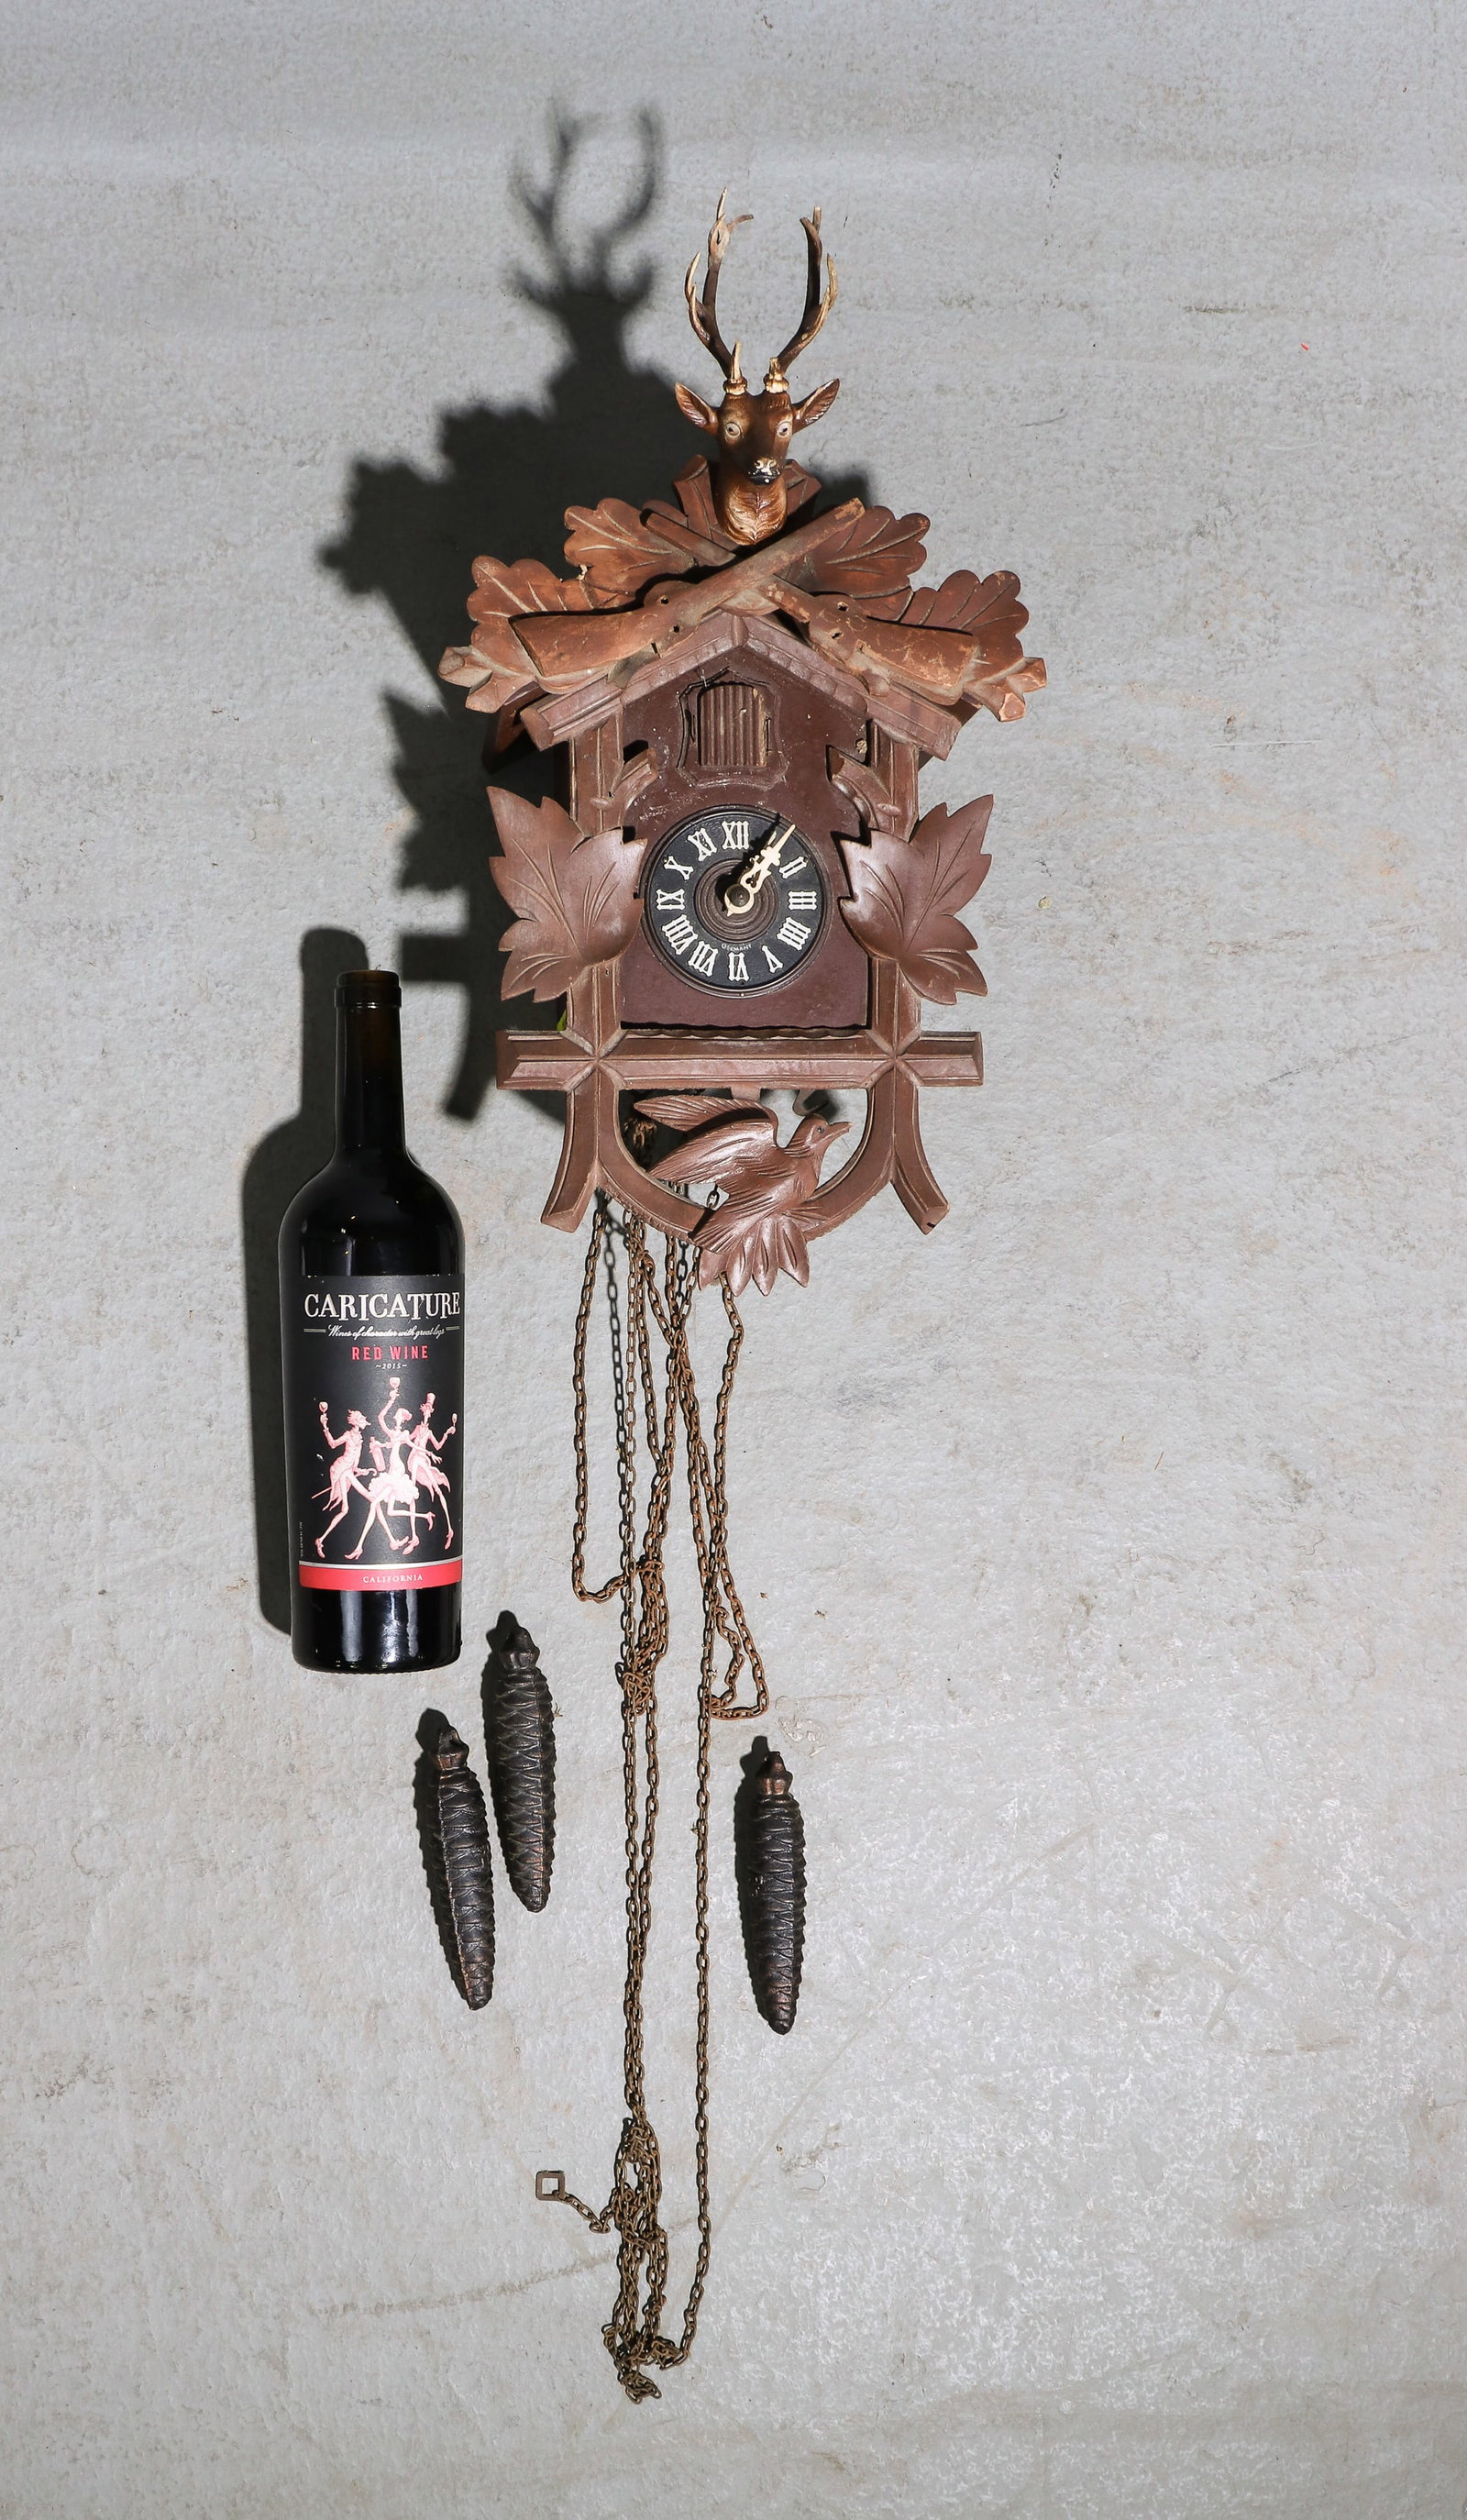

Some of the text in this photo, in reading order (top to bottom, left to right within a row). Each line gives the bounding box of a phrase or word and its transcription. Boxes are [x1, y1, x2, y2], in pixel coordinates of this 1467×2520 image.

[688, 828, 718, 861] XI
[722, 821, 750, 850] XII
[664, 856, 694, 880] X
[778, 856, 808, 879] II
[656, 888, 686, 911] IX
[788, 890, 818, 911] III
[661, 913, 699, 956] VIII
[777, 917, 812, 951] IIII
[688, 940, 719, 978] VII
[727, 952, 750, 981] VI
[761, 945, 784, 974] V
[303, 1292, 460, 1321] CARICATURE
[327, 1324, 352, 1337] Wines
[352, 1326, 363, 1341] of
[398, 1325, 415, 1340] with
[415, 1326, 434, 1340] great
[351, 1345, 429, 1361] RED WINE
[362, 1575, 424, 1584] CALIFORNIA
